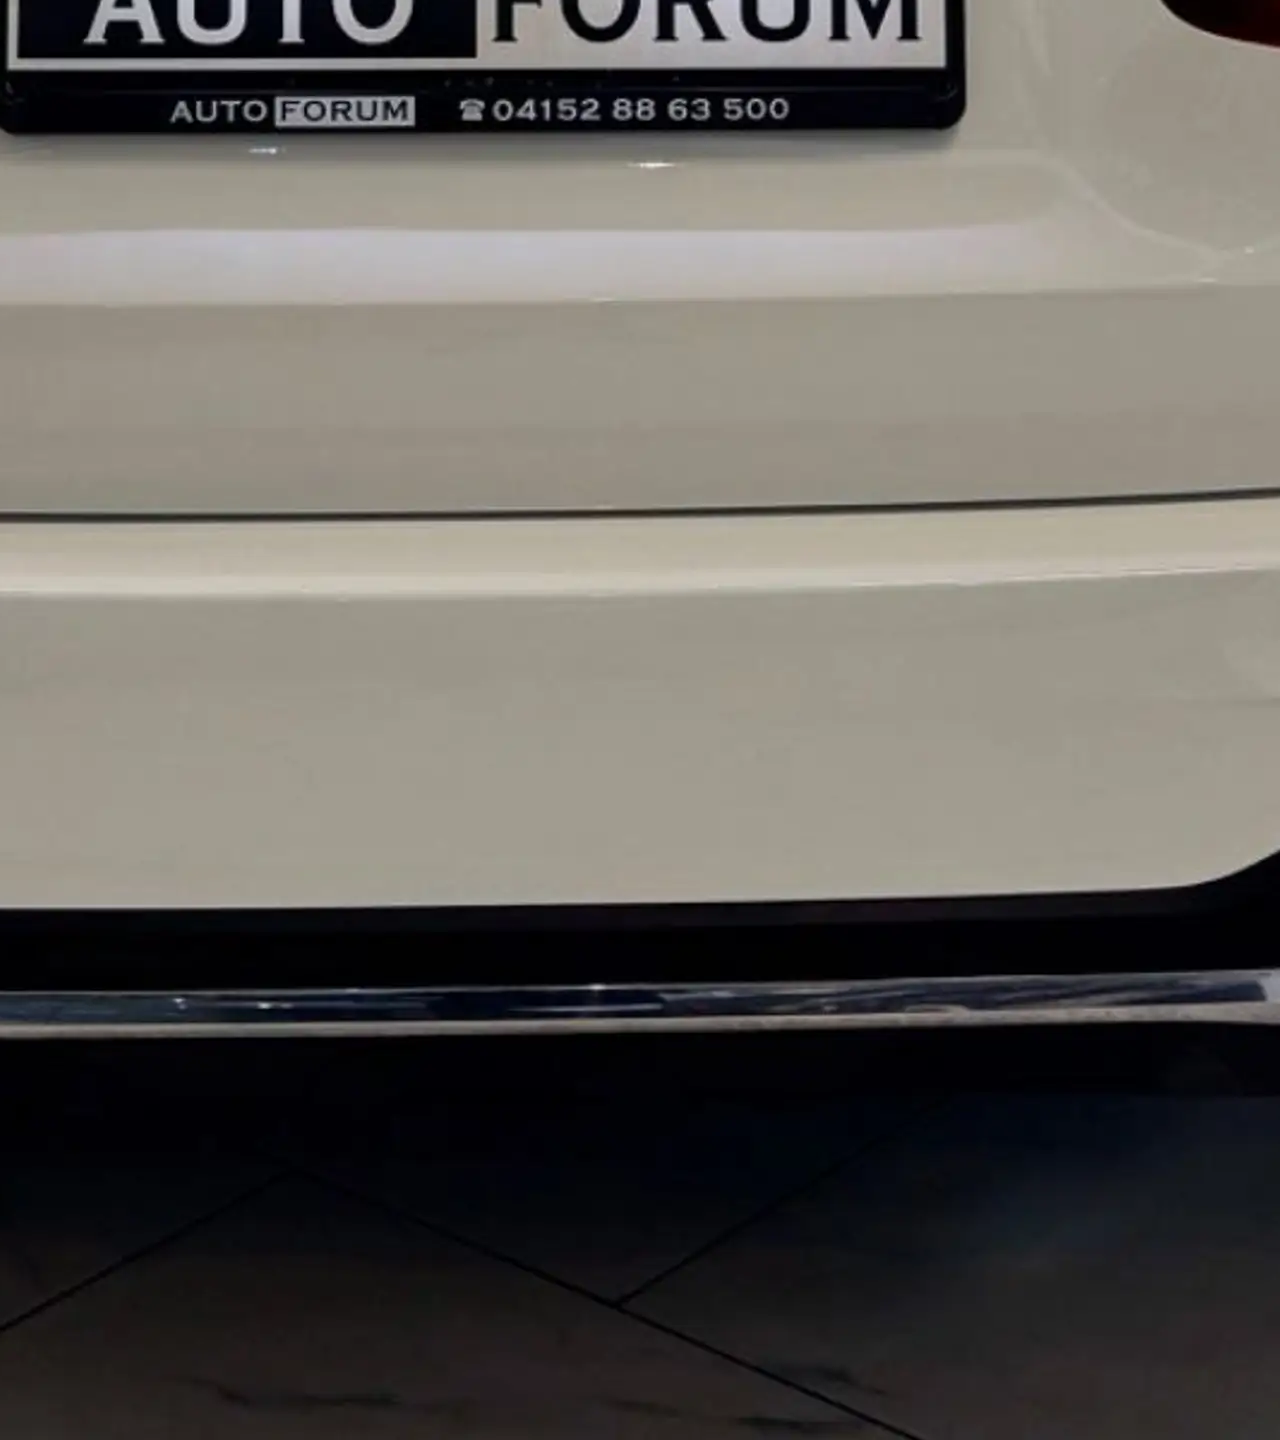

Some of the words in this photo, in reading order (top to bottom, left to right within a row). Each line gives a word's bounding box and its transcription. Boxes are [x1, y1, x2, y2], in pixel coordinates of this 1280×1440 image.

[170, 98, 270, 123] AUTO
[279, 99, 410, 122] FORUM
[492, 97, 602, 122] 04152
[613, 97, 658, 122] 88
[667, 97, 713, 122] 63
[722, 97, 791, 121] 500
